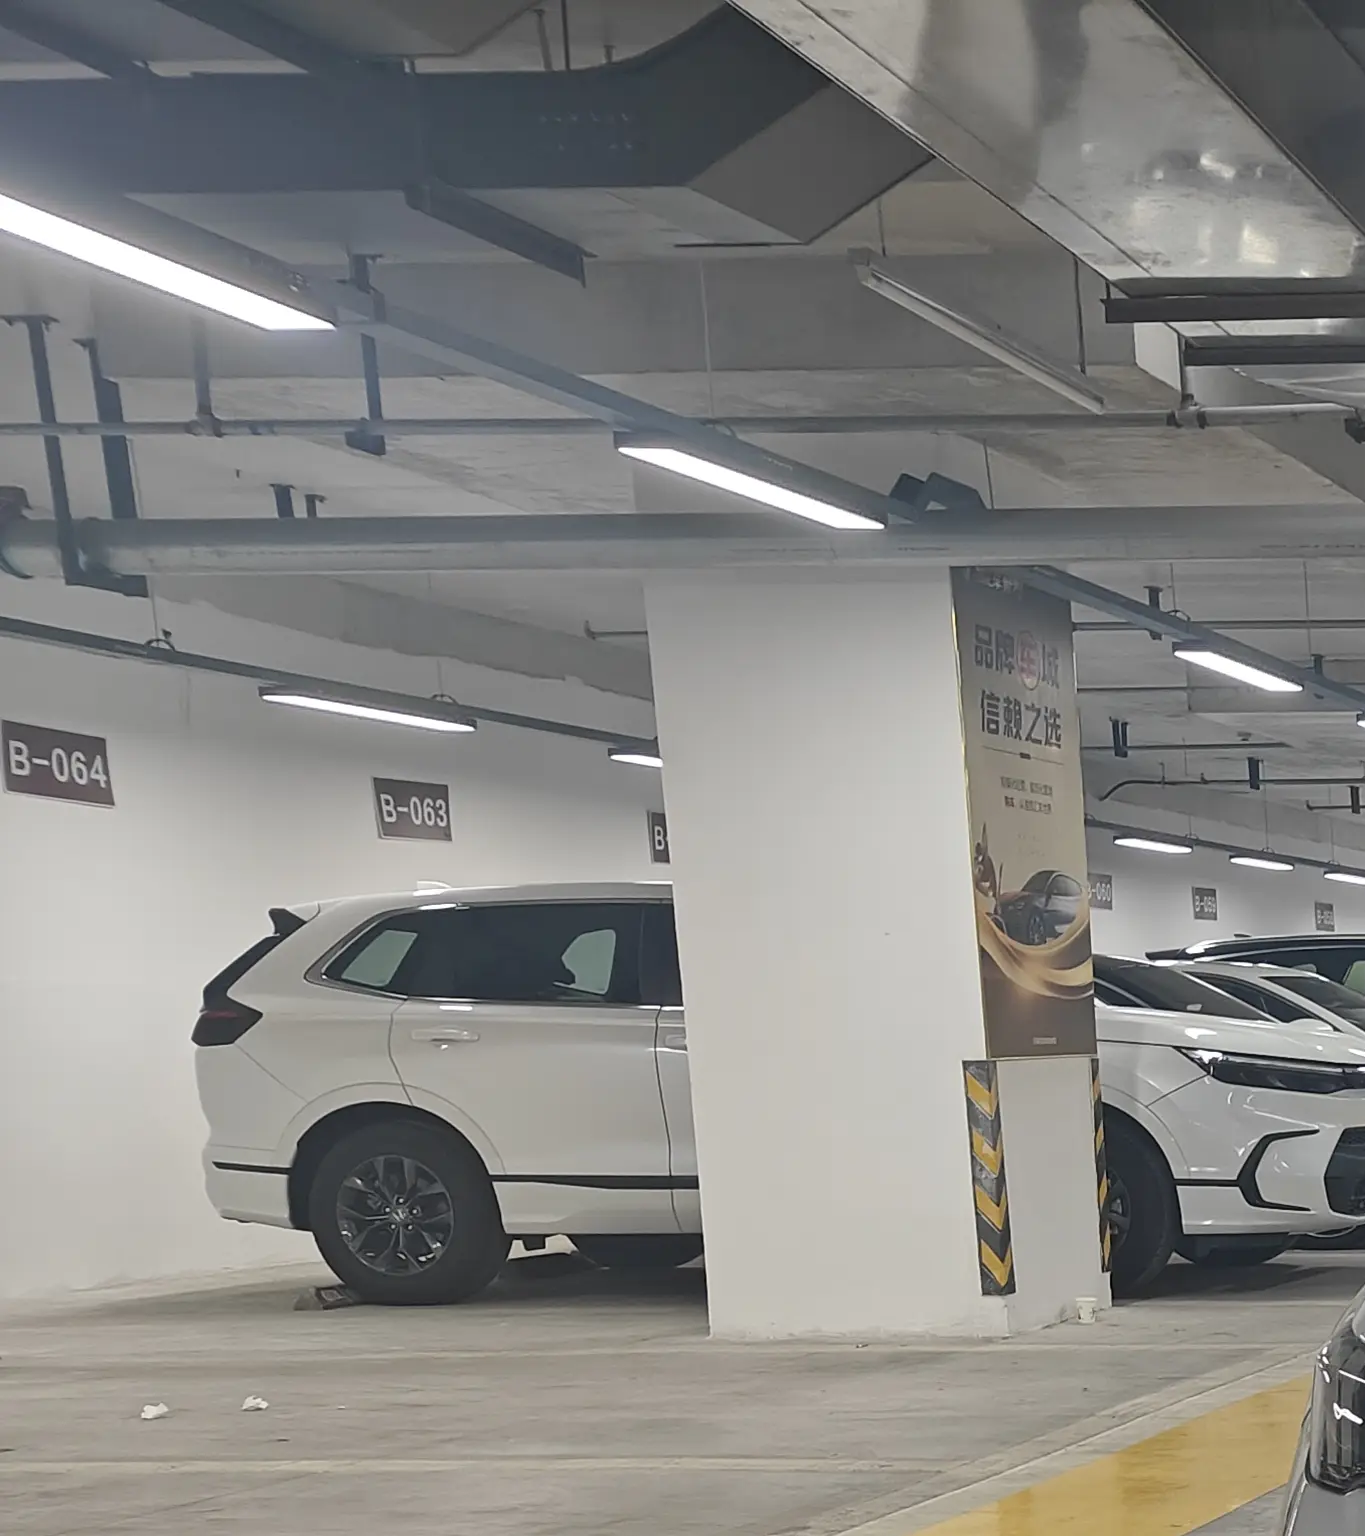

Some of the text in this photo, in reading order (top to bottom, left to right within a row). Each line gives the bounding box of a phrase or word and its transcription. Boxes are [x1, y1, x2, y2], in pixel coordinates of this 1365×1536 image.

[981, 689, 1061, 748] 信赖之选
[9, 740, 107, 788] B-064
[380, 793, 448, 827] B-063
